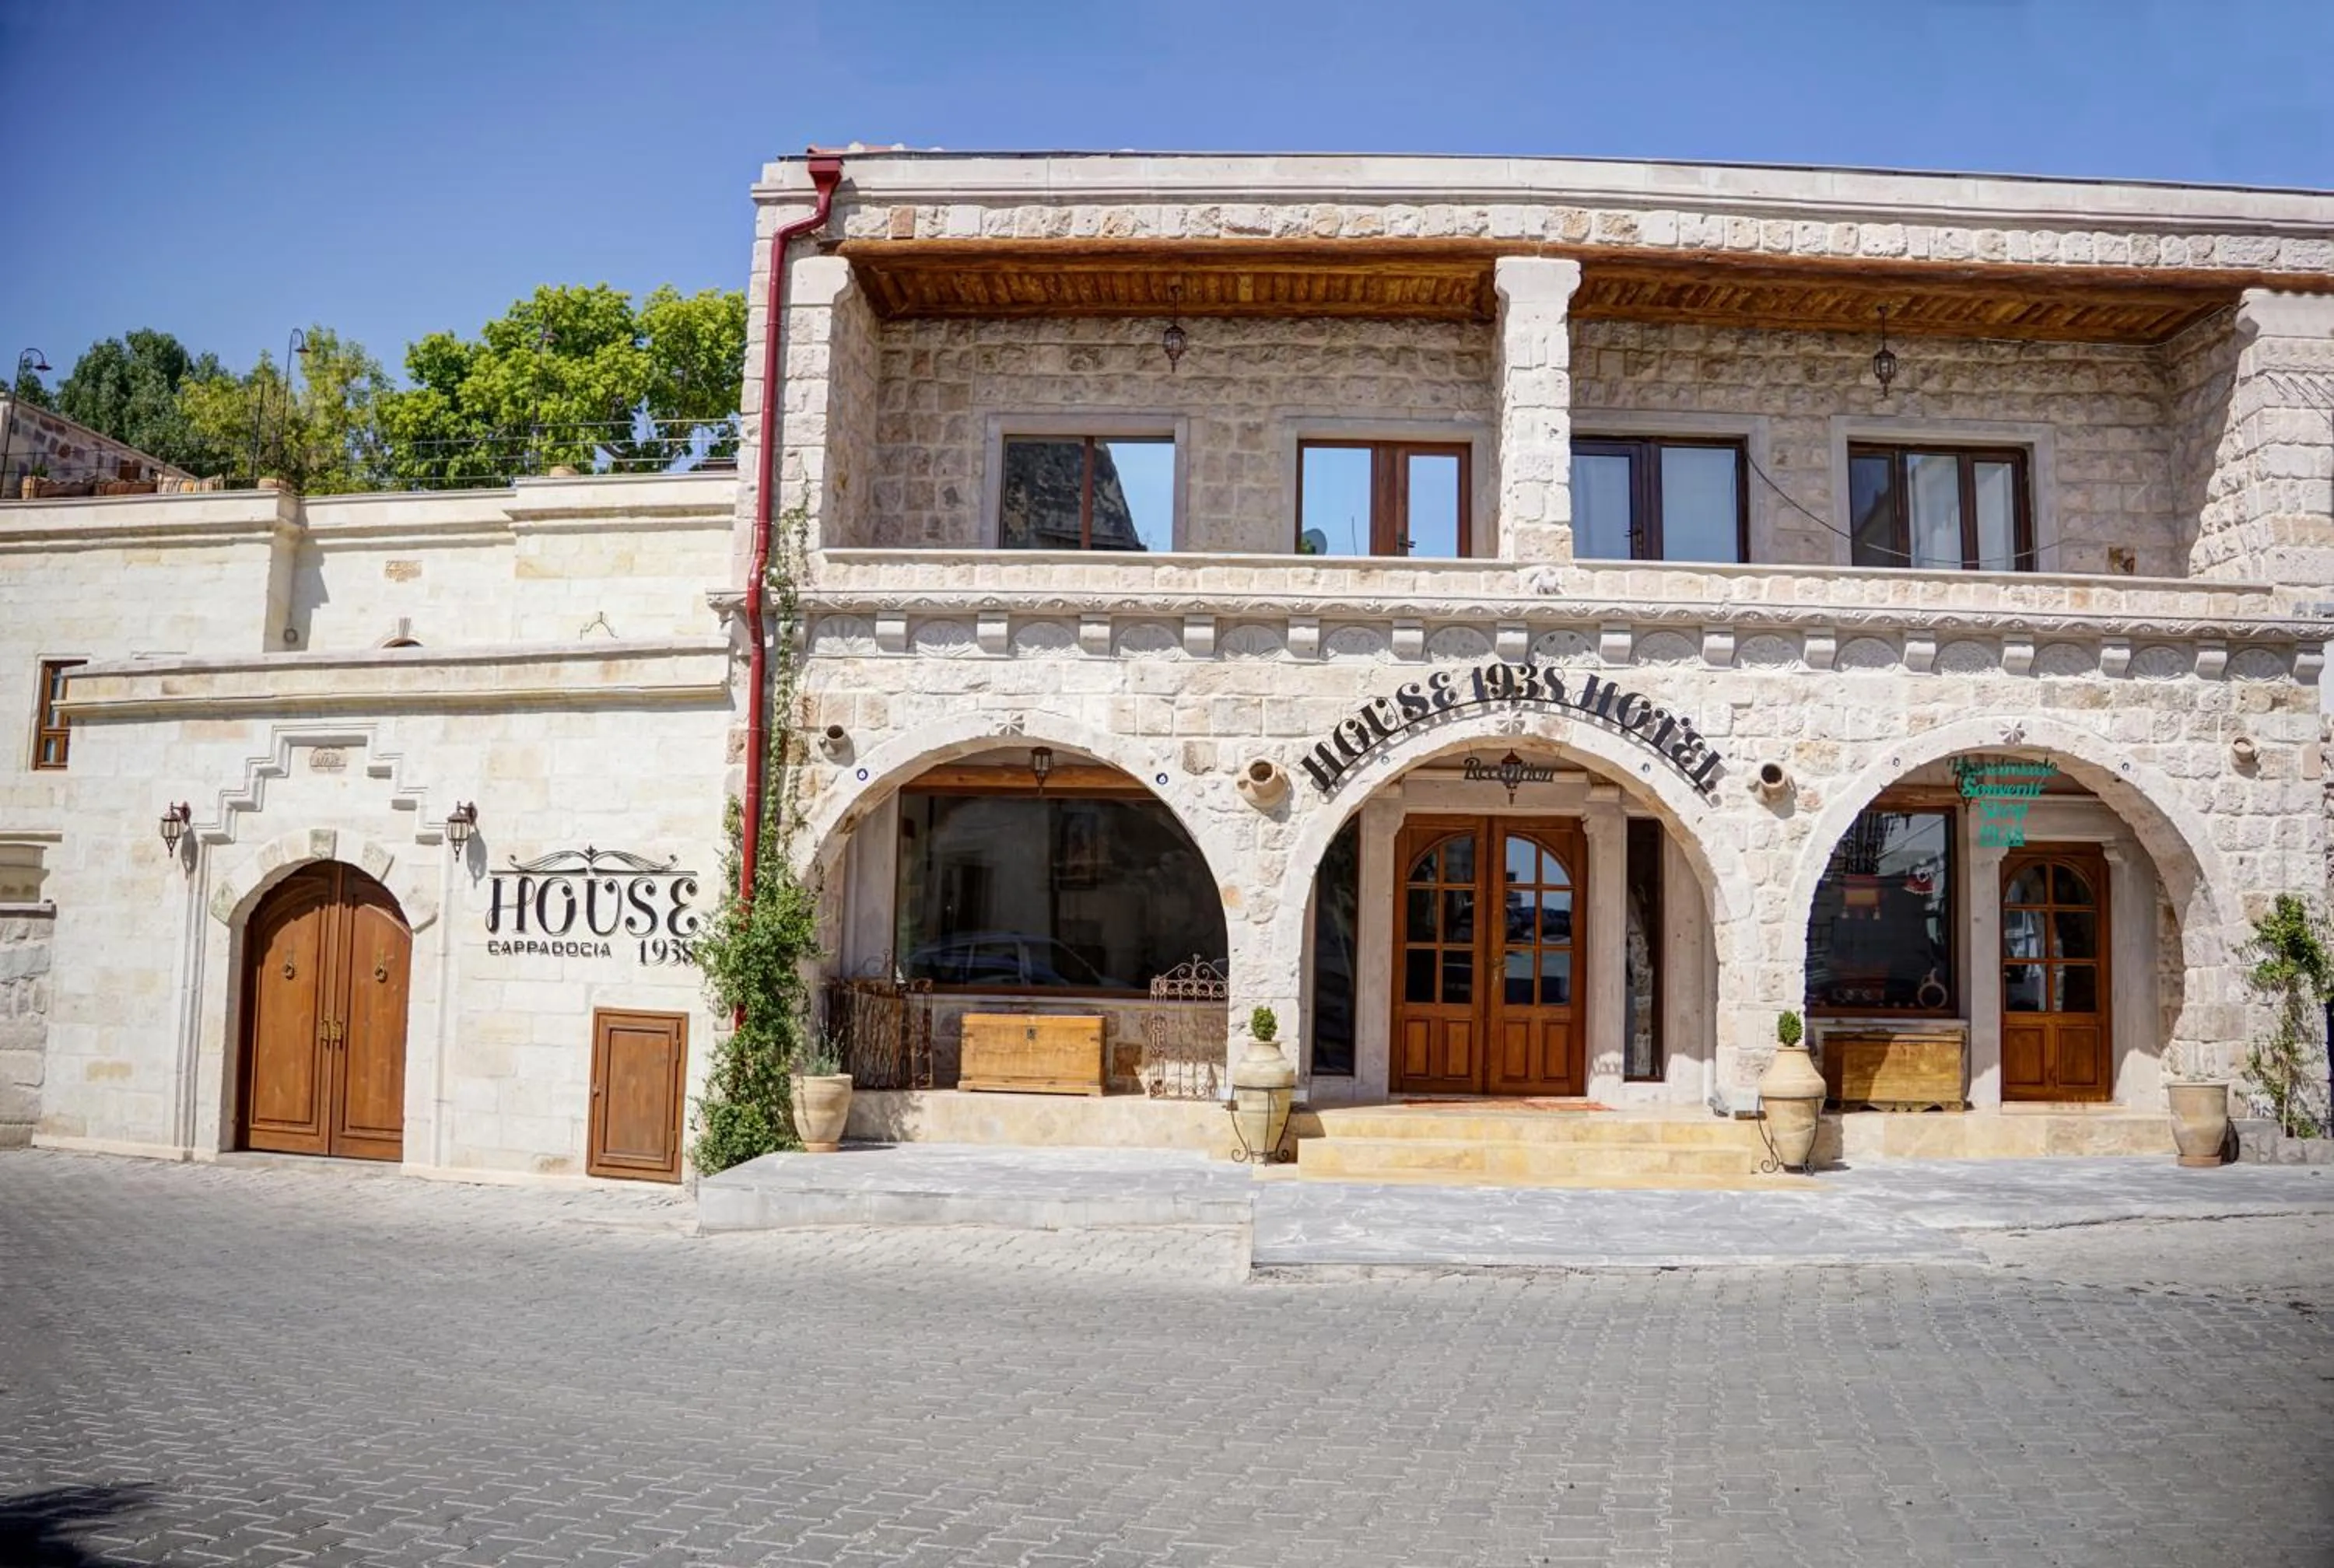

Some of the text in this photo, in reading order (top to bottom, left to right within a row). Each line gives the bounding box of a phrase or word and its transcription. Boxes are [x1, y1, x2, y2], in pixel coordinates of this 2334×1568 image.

[1300, 671, 1460, 793] HOUSE
[1573, 674, 1721, 793] HOTEL
[485, 876, 699, 936] HOUSE
[488, 940, 612, 958] CAPPADOCIA
